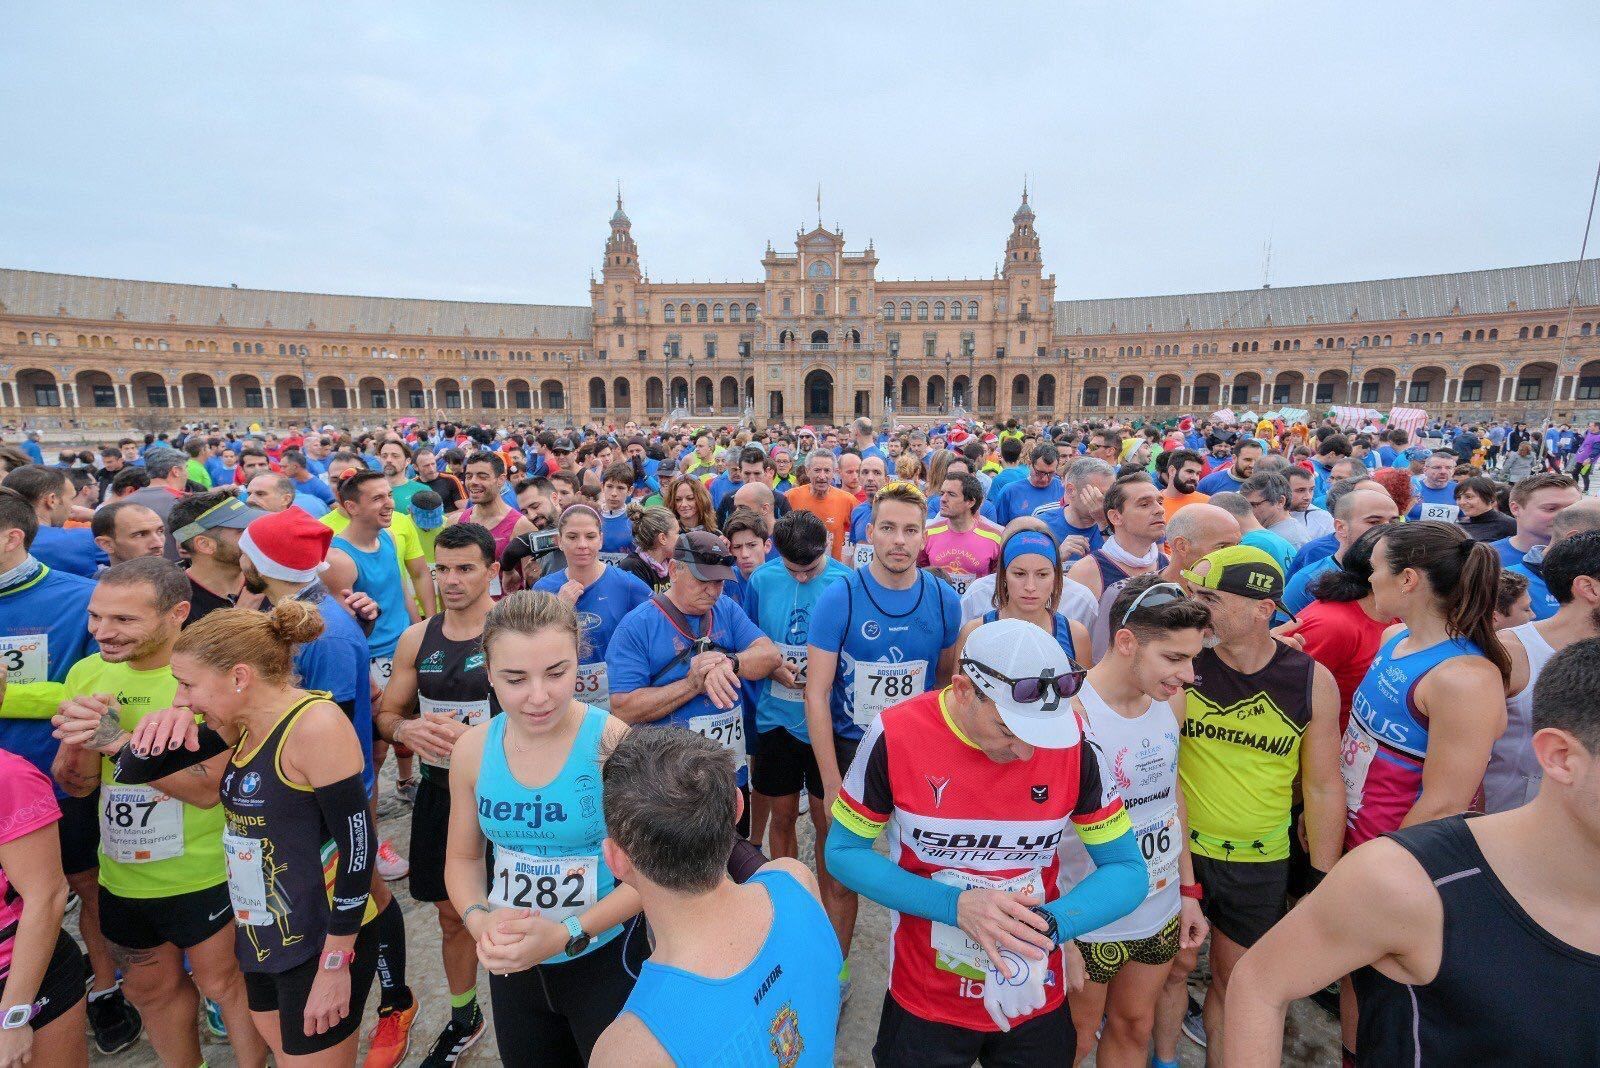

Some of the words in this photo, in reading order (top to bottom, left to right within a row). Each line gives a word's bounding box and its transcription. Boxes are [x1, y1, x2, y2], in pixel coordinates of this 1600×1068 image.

[1427, 508, 1450, 518] 821
[857, 550, 874, 563] 631
[935, 549, 980, 566] GUADIAMAR
[1248, 571, 1274, 588] ITZ
[877, 668, 908, 676] ADSEVILLA
[867, 675, 913, 697] 788
[104, 800, 158, 828] 487
[479, 794, 568, 829] nerja
[1136, 826, 1171, 860] 06
[514, 861, 561, 876] ADSEVILLA
[500, 868, 585, 909] 1282
[753, 963, 783, 1006] VIATOR
